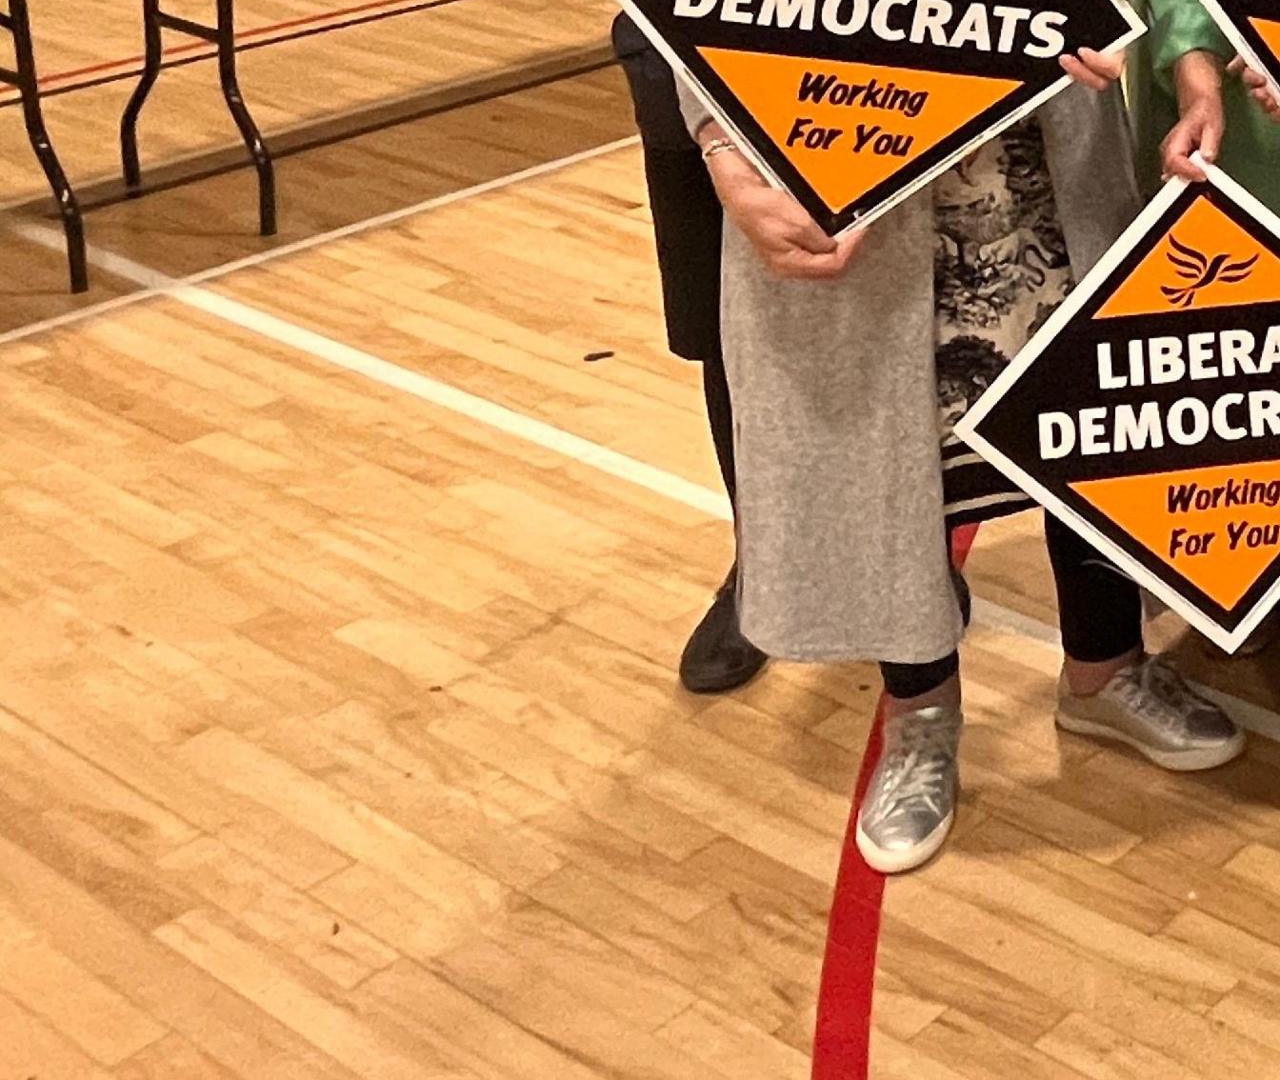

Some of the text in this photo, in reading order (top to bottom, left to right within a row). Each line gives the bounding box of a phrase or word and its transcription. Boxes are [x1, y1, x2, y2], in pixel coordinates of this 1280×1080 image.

[798, 71, 929, 118] Working
[786, 118, 842, 150] For
[853, 125, 914, 157] You
[1169, 528, 1215, 558] For
[1227, 520, 1280, 550] You
